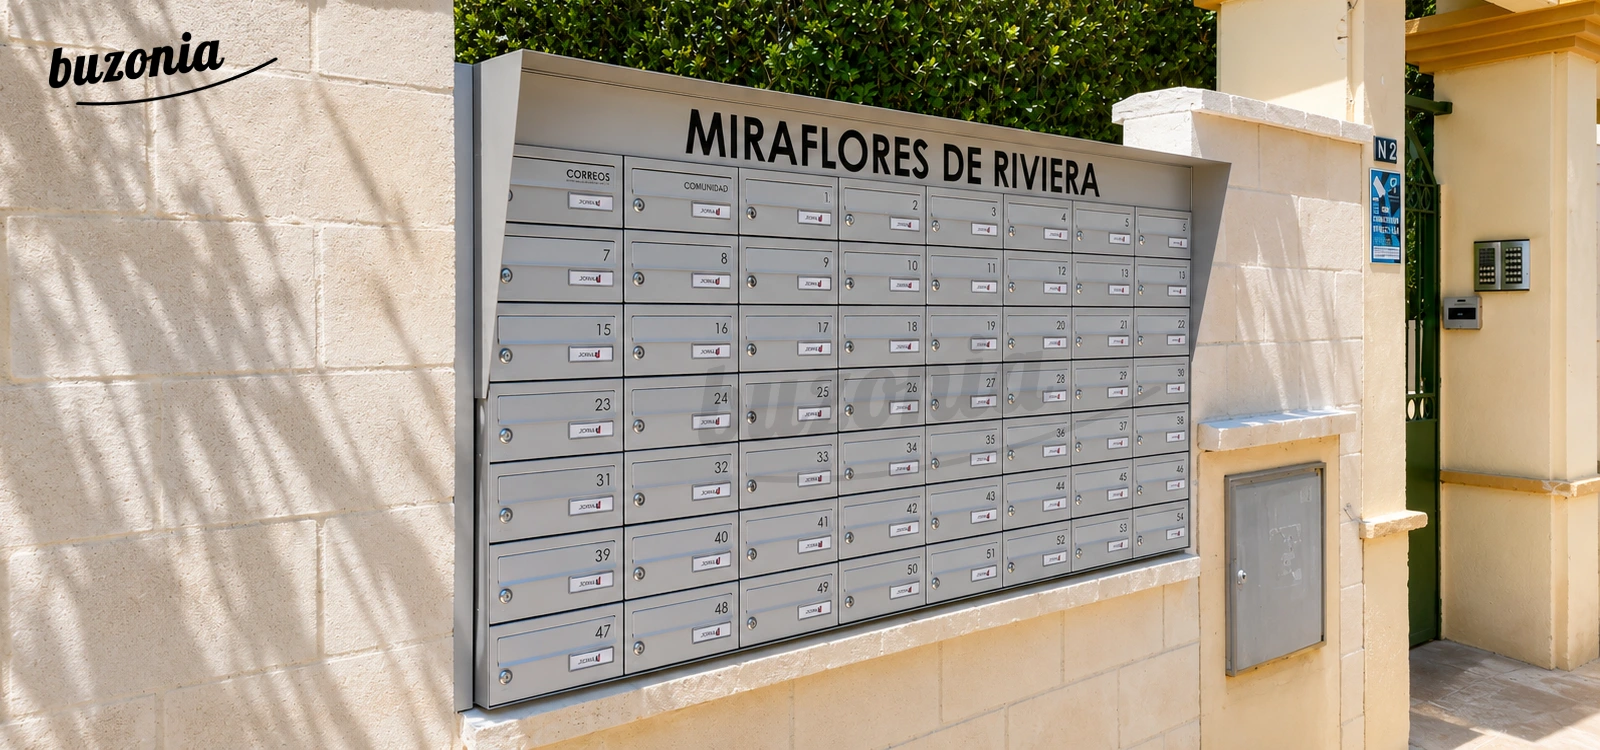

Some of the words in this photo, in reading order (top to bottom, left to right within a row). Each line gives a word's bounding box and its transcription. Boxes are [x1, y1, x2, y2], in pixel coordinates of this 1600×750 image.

[685, 108, 929, 180] MIRAFLORES
[943, 143, 982, 185] DE
[993, 149, 1101, 198] RIVIERA
[1389, 142, 1397, 161] 2
[566, 168, 611, 182] CORREOS
[683, 181, 729, 193] COMUNIDAD
[912, 200, 919, 211] 2
[603, 249, 610, 261] 7
[721, 252, 728, 264] 8
[822, 257, 830, 268] 9
[908, 260, 918, 271] 10
[988, 263, 995, 273] 11
[1058, 266, 1066, 276] 12
[1121, 269, 1129, 278] 13
[597, 323, 611, 336] 15
[716, 322, 728, 334] 16
[818, 322, 829, 333] 17
[908, 321, 917, 332] 18
[987, 321, 996, 330] 19
[1056, 320, 1065, 330] 20
[1120, 320, 1127, 329] 21
[1057, 374, 1065, 384] 28
[1120, 371, 1127, 380] 29
[907, 382, 917, 393] 26
[986, 378, 996, 387] 27
[817, 386, 829, 398] 25
[714, 392, 728, 405] 24
[595, 398, 611, 411] 23
[1119, 421, 1127, 431] 37
[1057, 428, 1065, 437] 36
[986, 435, 995, 445] 35
[907, 442, 917, 453] 34
[817, 451, 829, 463] 33
[715, 461, 728, 474] 32
[596, 473, 610, 487] 31
[1119, 473, 1127, 481] 45
[986, 491, 995, 501] 43
[907, 503, 917, 514] 42
[818, 516, 828, 527] 41
[1120, 523, 1127, 533] 53
[714, 531, 728, 544] 40
[1057, 535, 1065, 545] 52
[595, 548, 610, 562] 39
[987, 548, 995, 559] 51
[907, 563, 918, 575] 50
[817, 581, 828, 593] 49
[715, 601, 728, 614] 48
[595, 624, 611, 638] 47
